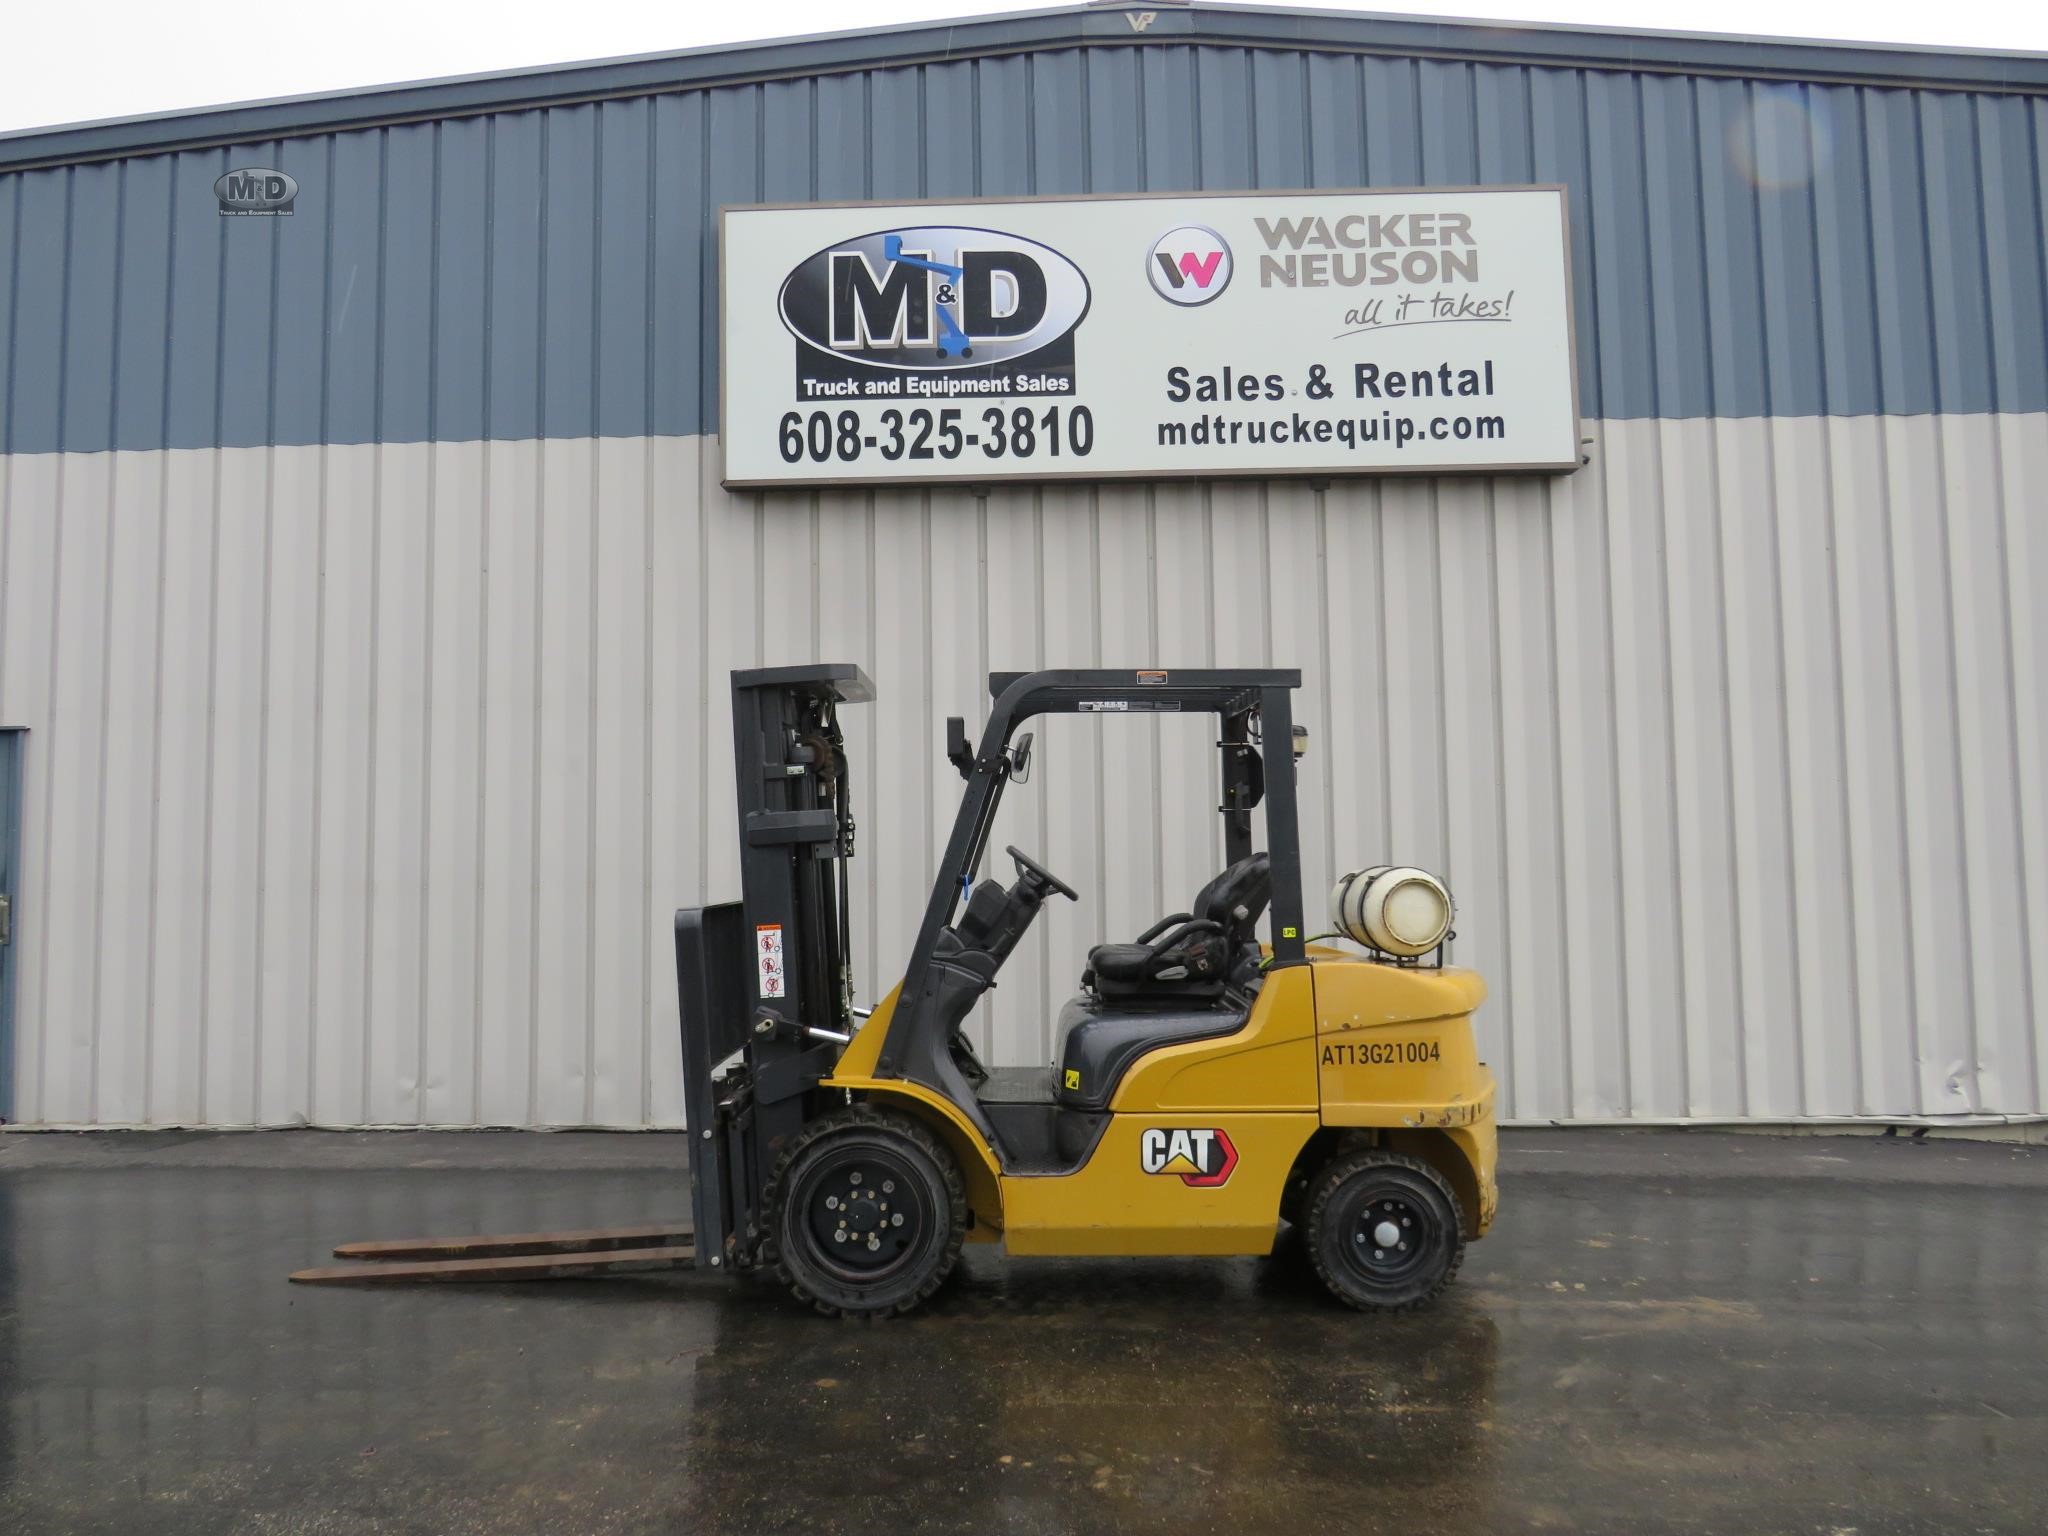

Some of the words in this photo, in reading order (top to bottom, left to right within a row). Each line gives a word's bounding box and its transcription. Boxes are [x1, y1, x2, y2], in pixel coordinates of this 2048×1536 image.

[1253, 212, 1477, 251] WACKER
[1259, 249, 1479, 289] NEUSON
[828, 248, 1048, 350] M&D
[1344, 298, 1382, 325] all
[1395, 293, 1424, 321] it
[1431, 290, 1515, 319] takes!
[803, 378, 860, 397] Truck
[864, 376, 900, 395] and
[906, 374, 1010, 396] Equipment
[1015, 373, 1070, 393] Sales
[1166, 365, 1285, 403] Sales
[1305, 364, 1334, 400] &
[1354, 359, 1494, 399] Rental
[778, 404, 1095, 464] 608-325-3810
[1157, 410, 1506, 450] mdtruckequip.com
[1321, 1042, 1441, 1066] AT13G21004
[1142, 1129, 1214, 1174] CAT
